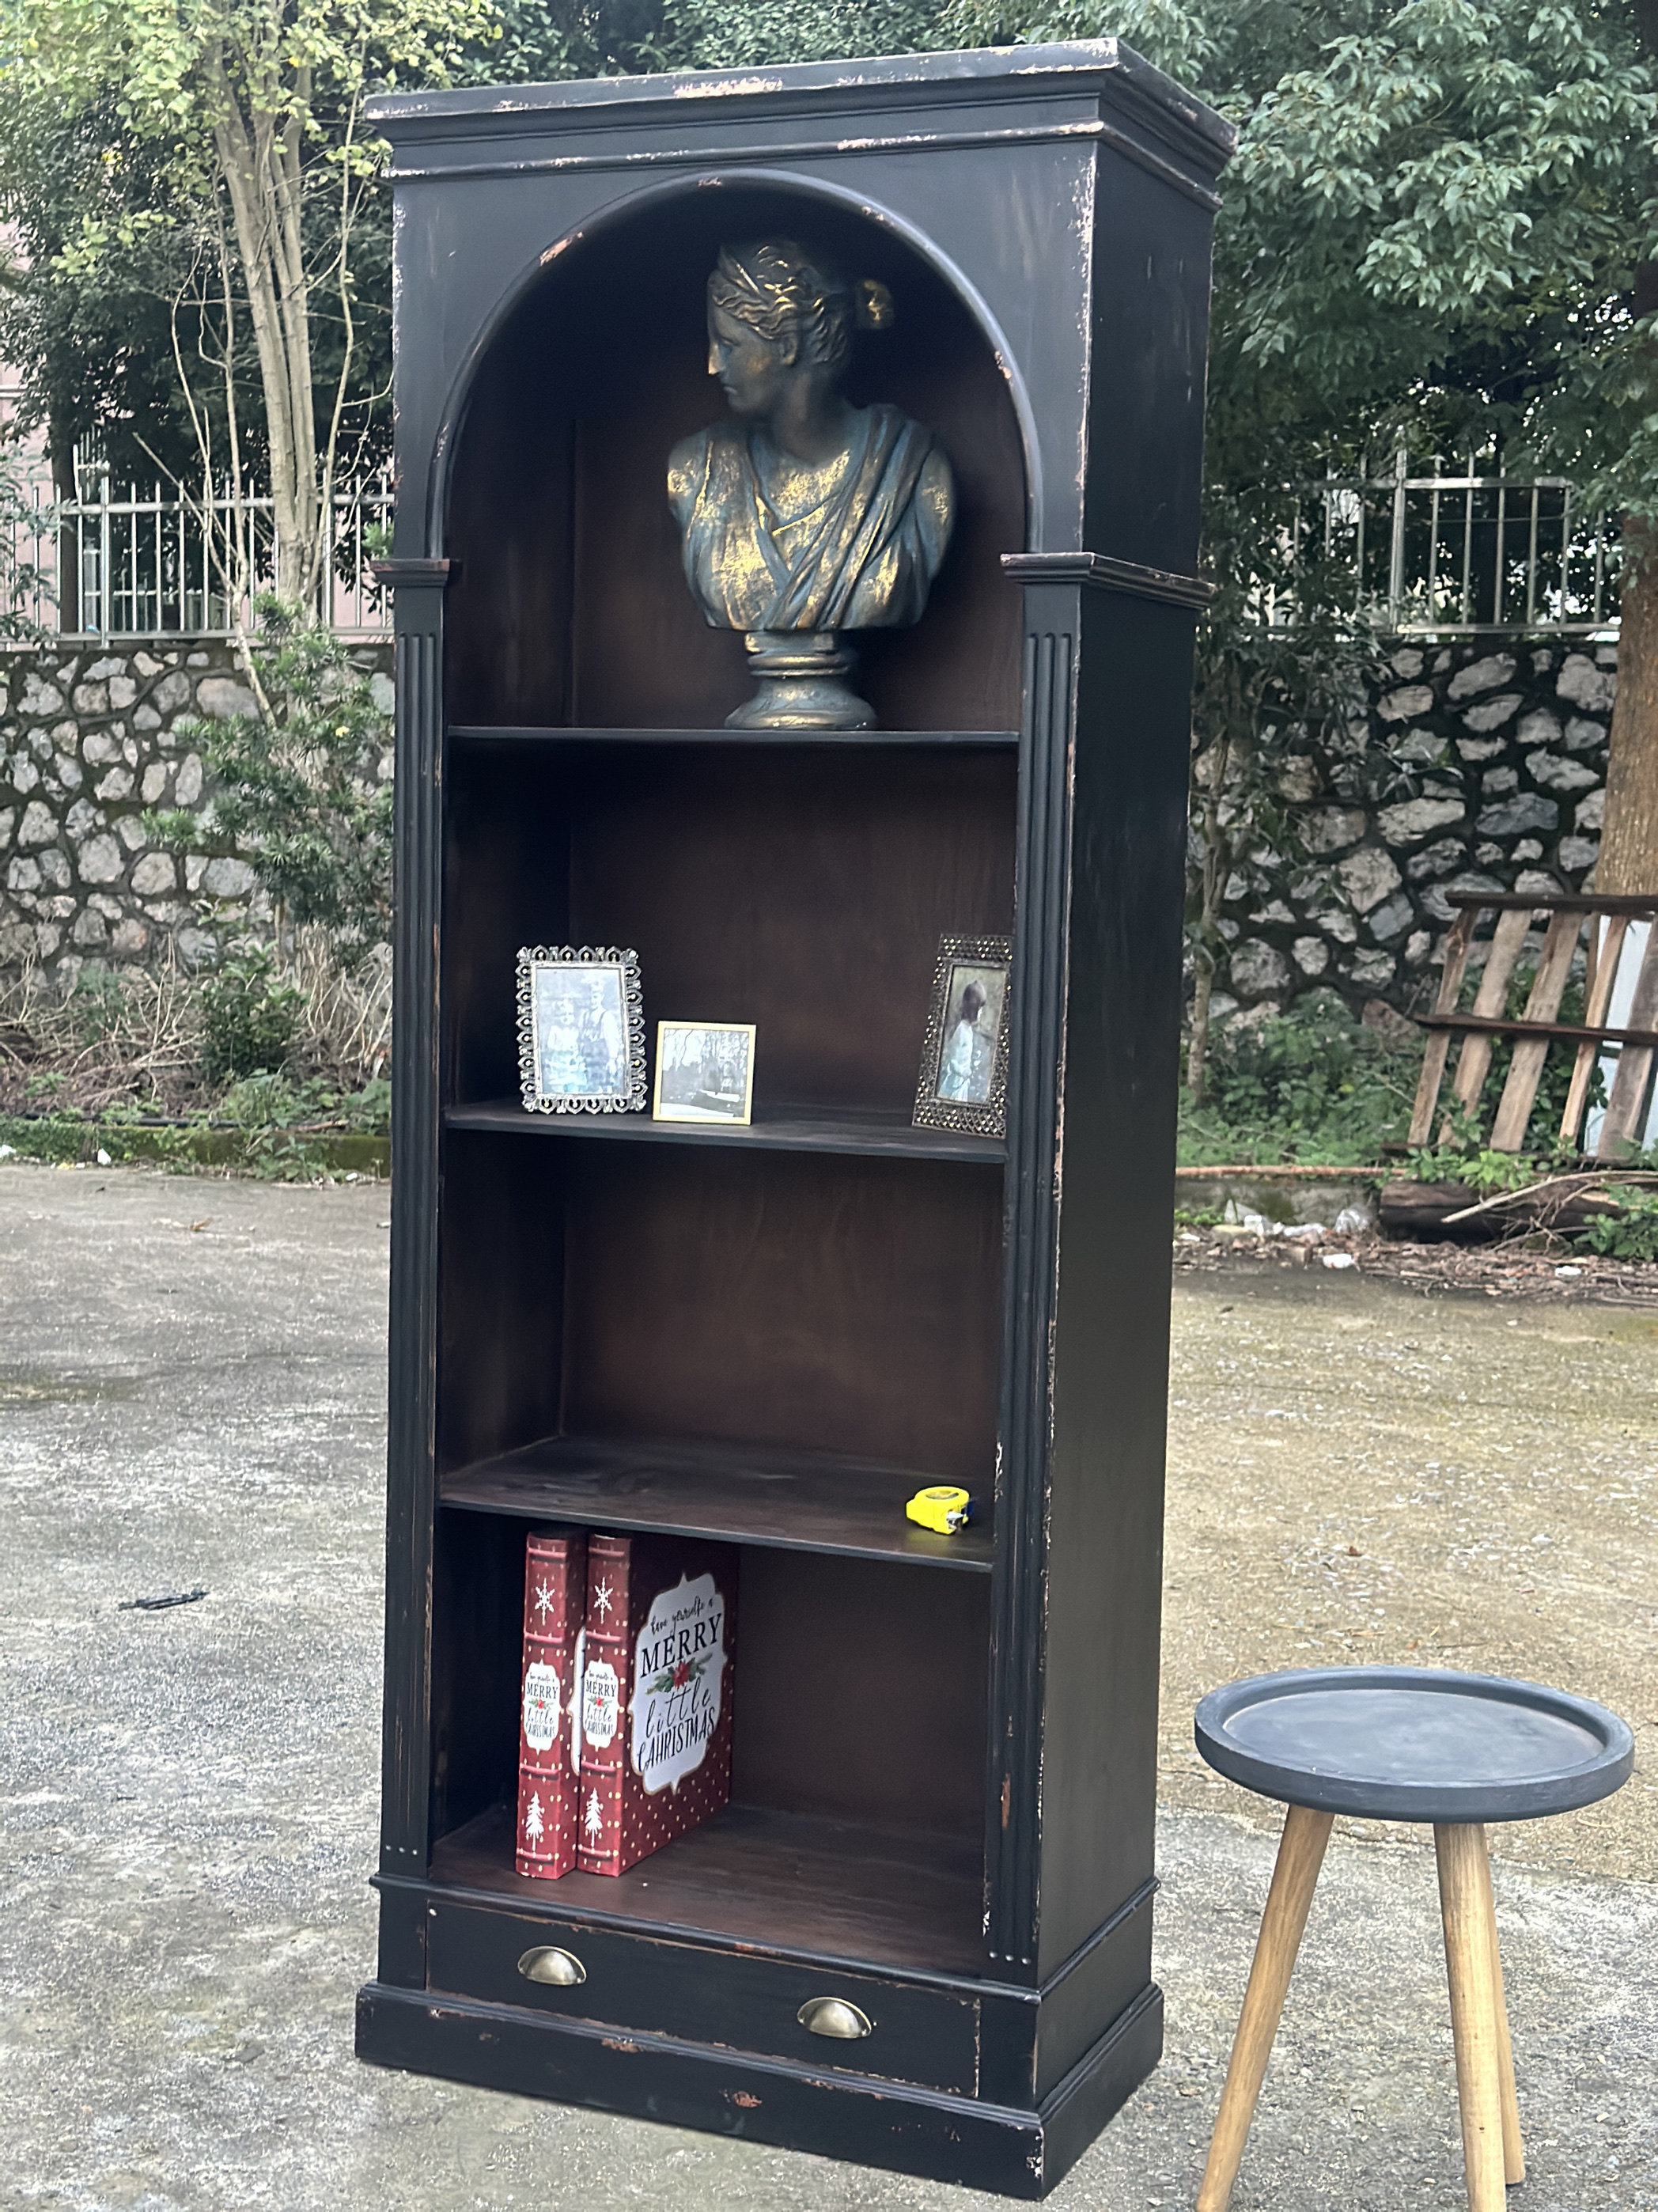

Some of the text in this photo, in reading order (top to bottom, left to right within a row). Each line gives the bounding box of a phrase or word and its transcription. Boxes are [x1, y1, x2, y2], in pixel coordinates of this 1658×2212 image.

[641, 1612, 721, 1678] MERRY
[527, 1681, 558, 1699] MERRY
[586, 1680, 616, 1698] MERRY
[528, 1706, 554, 1725] little
[586, 1704, 612, 1722] little
[646, 1676, 712, 1739] little
